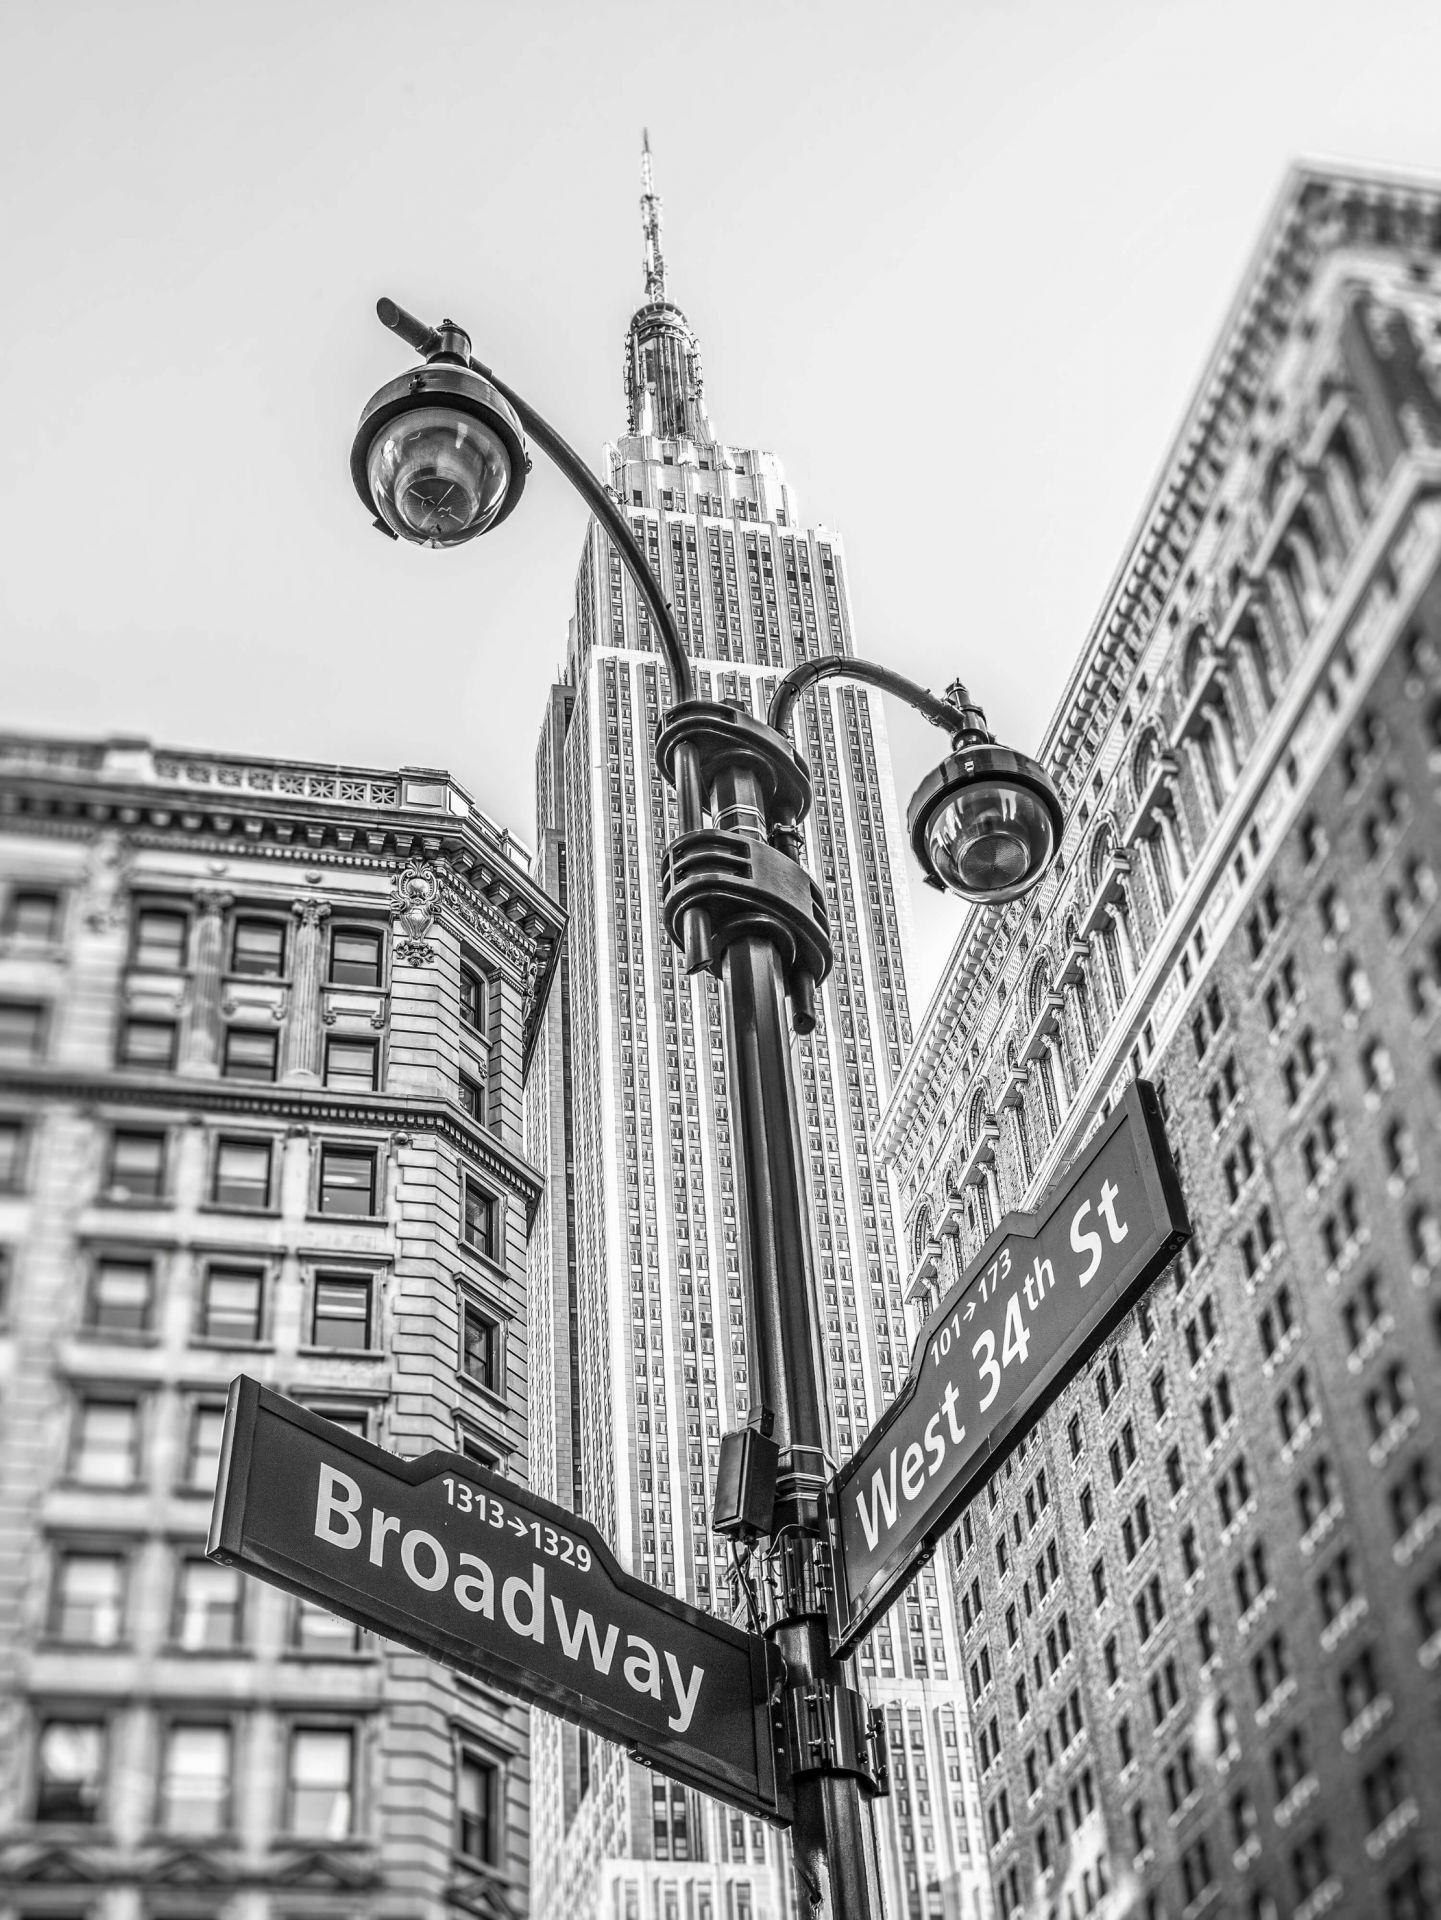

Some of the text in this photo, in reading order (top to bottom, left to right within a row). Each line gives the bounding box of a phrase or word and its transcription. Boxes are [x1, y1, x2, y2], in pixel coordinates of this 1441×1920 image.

[855, 1178, 1129, 1553] West 34th St
[930, 1247, 1012, 1368] 101 173
[314, 1461, 705, 1733] Broadway
[442, 1478, 592, 1573] 1313 1329
